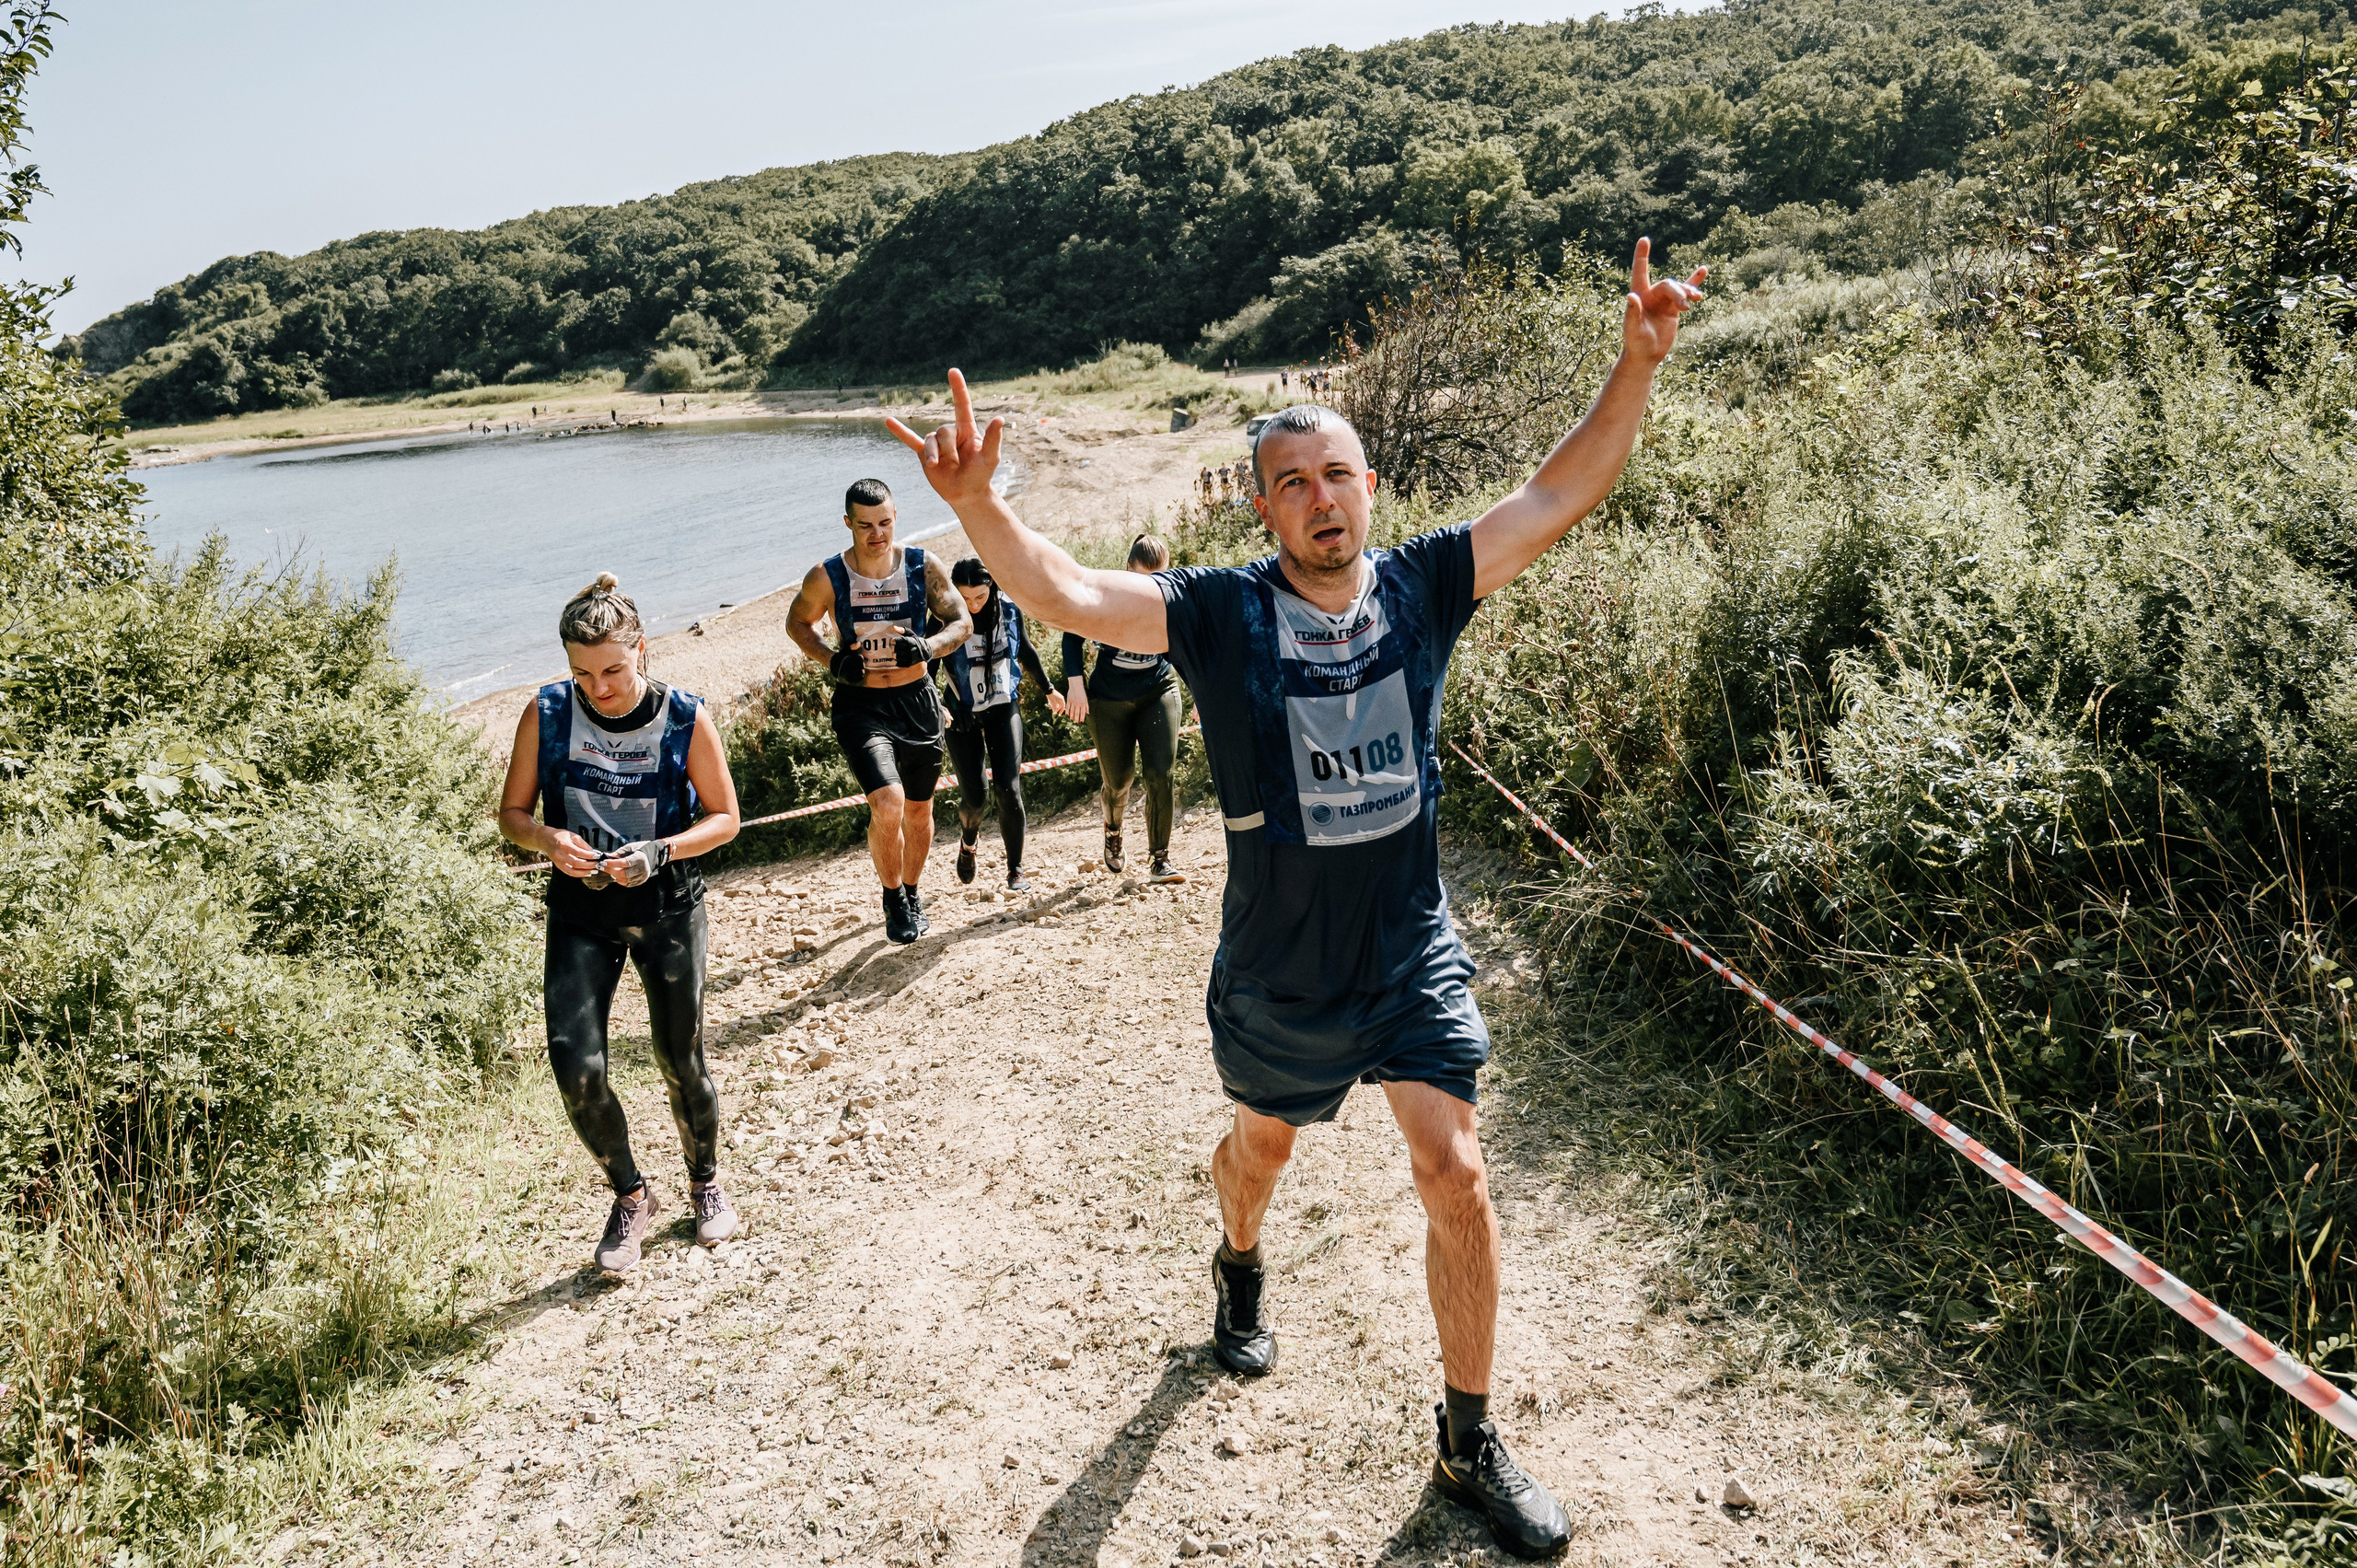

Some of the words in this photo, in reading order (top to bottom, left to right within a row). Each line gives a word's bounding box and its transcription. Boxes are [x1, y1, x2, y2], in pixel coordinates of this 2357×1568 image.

[862, 604, 900, 614] КОМАНДНЫЙ
[1295, 630, 1334, 642] ГОНКА
[863, 638, 893, 651] 011
[1305, 644, 1379, 678] КОМАНДНЫЙ
[1329, 673, 1364, 691] СТАРТ
[612, 750, 647, 759] ГЕРОЕВ
[1310, 732, 1404, 781] 01108
[583, 766, 643, 785] КОМАНДНЫЙ
[598, 782, 624, 796] СТАРТ
[1340, 783, 1416, 818] ГАЗПРОМБАНК
